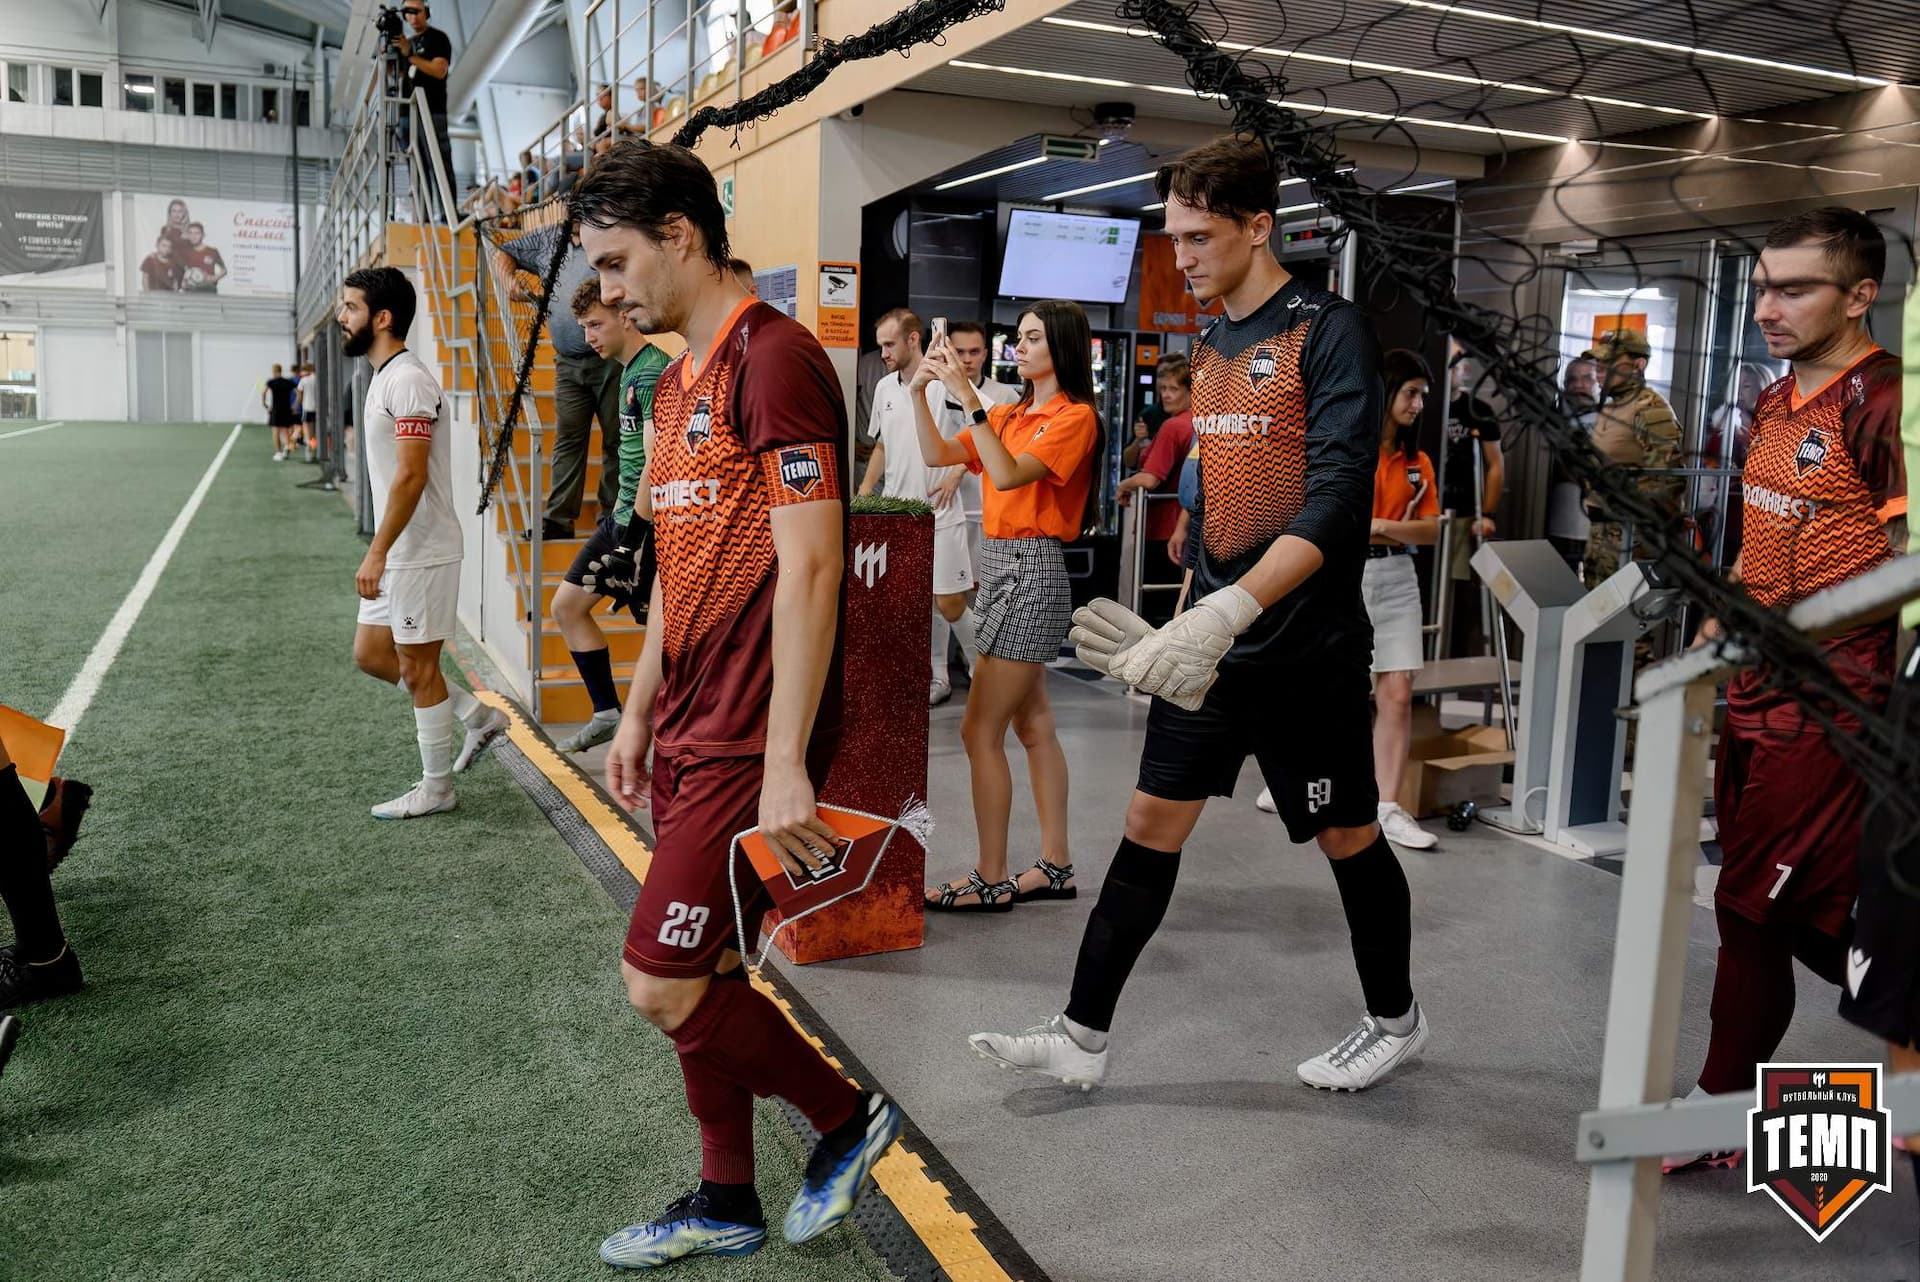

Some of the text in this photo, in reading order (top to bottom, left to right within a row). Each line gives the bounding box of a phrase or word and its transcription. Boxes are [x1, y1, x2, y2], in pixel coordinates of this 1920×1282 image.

[233, 211, 297, 229] Спасиб
[1250, 358, 1274, 376] ТЕМП
[1798, 441, 1826, 462] ТЕМП
[783, 459, 818, 480] ТЕМП
[1307, 778, 1331, 813] 59
[1768, 863, 1793, 900] 7
[657, 901, 710, 949] 23
